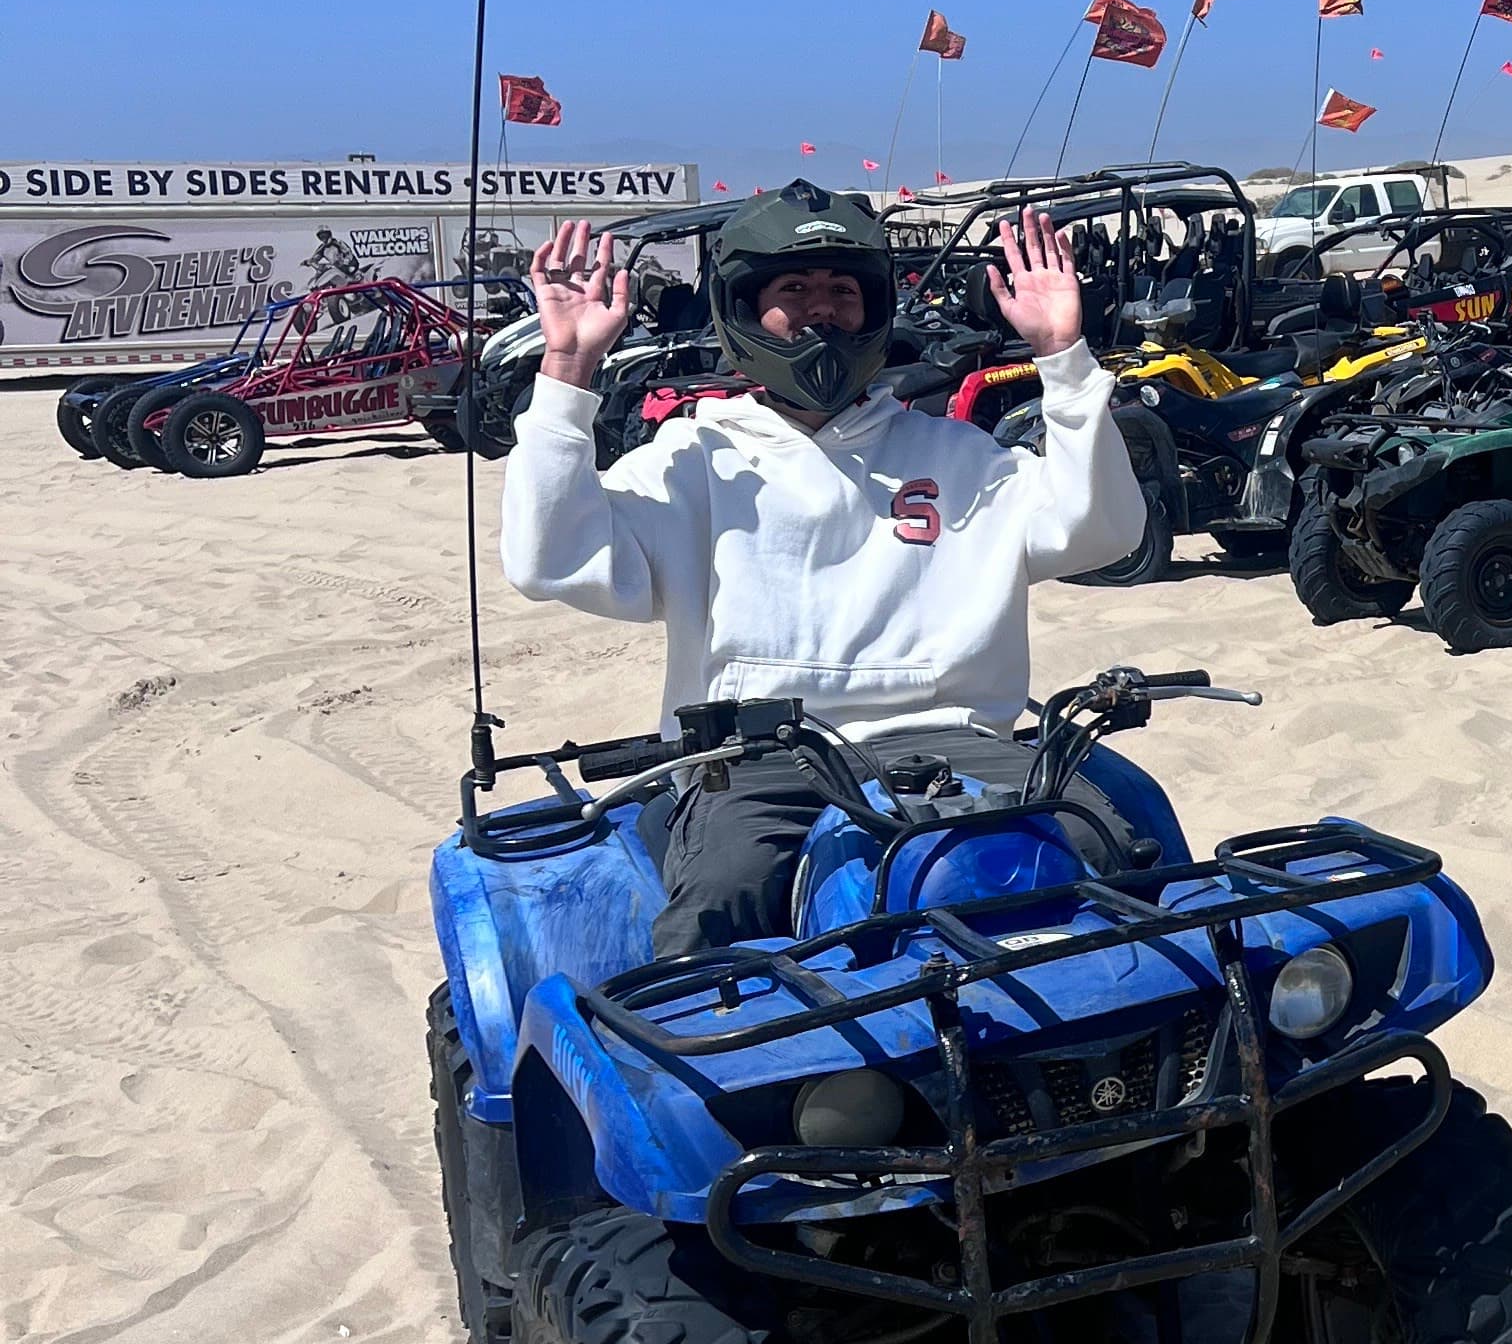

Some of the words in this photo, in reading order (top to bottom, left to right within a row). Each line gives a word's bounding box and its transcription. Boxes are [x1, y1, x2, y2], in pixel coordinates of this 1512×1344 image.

[26, 169, 113, 197] SIDE
[127, 170, 173, 196] BY
[187, 169, 289, 197] SIDES
[302, 169, 452, 196] RENTALS
[481, 170, 606, 195] STEVE'S
[616, 171, 675, 195] ATV
[350, 227, 429, 244] WALK-UPS
[354, 240, 430, 257] WELCOME
[61, 293, 145, 343] ATV
[139, 279, 295, 334] RENTALS
[1454, 293, 1495, 322] SUN
[257, 382, 399, 426] SUNBUGGIE
[890, 478, 940, 546] S
